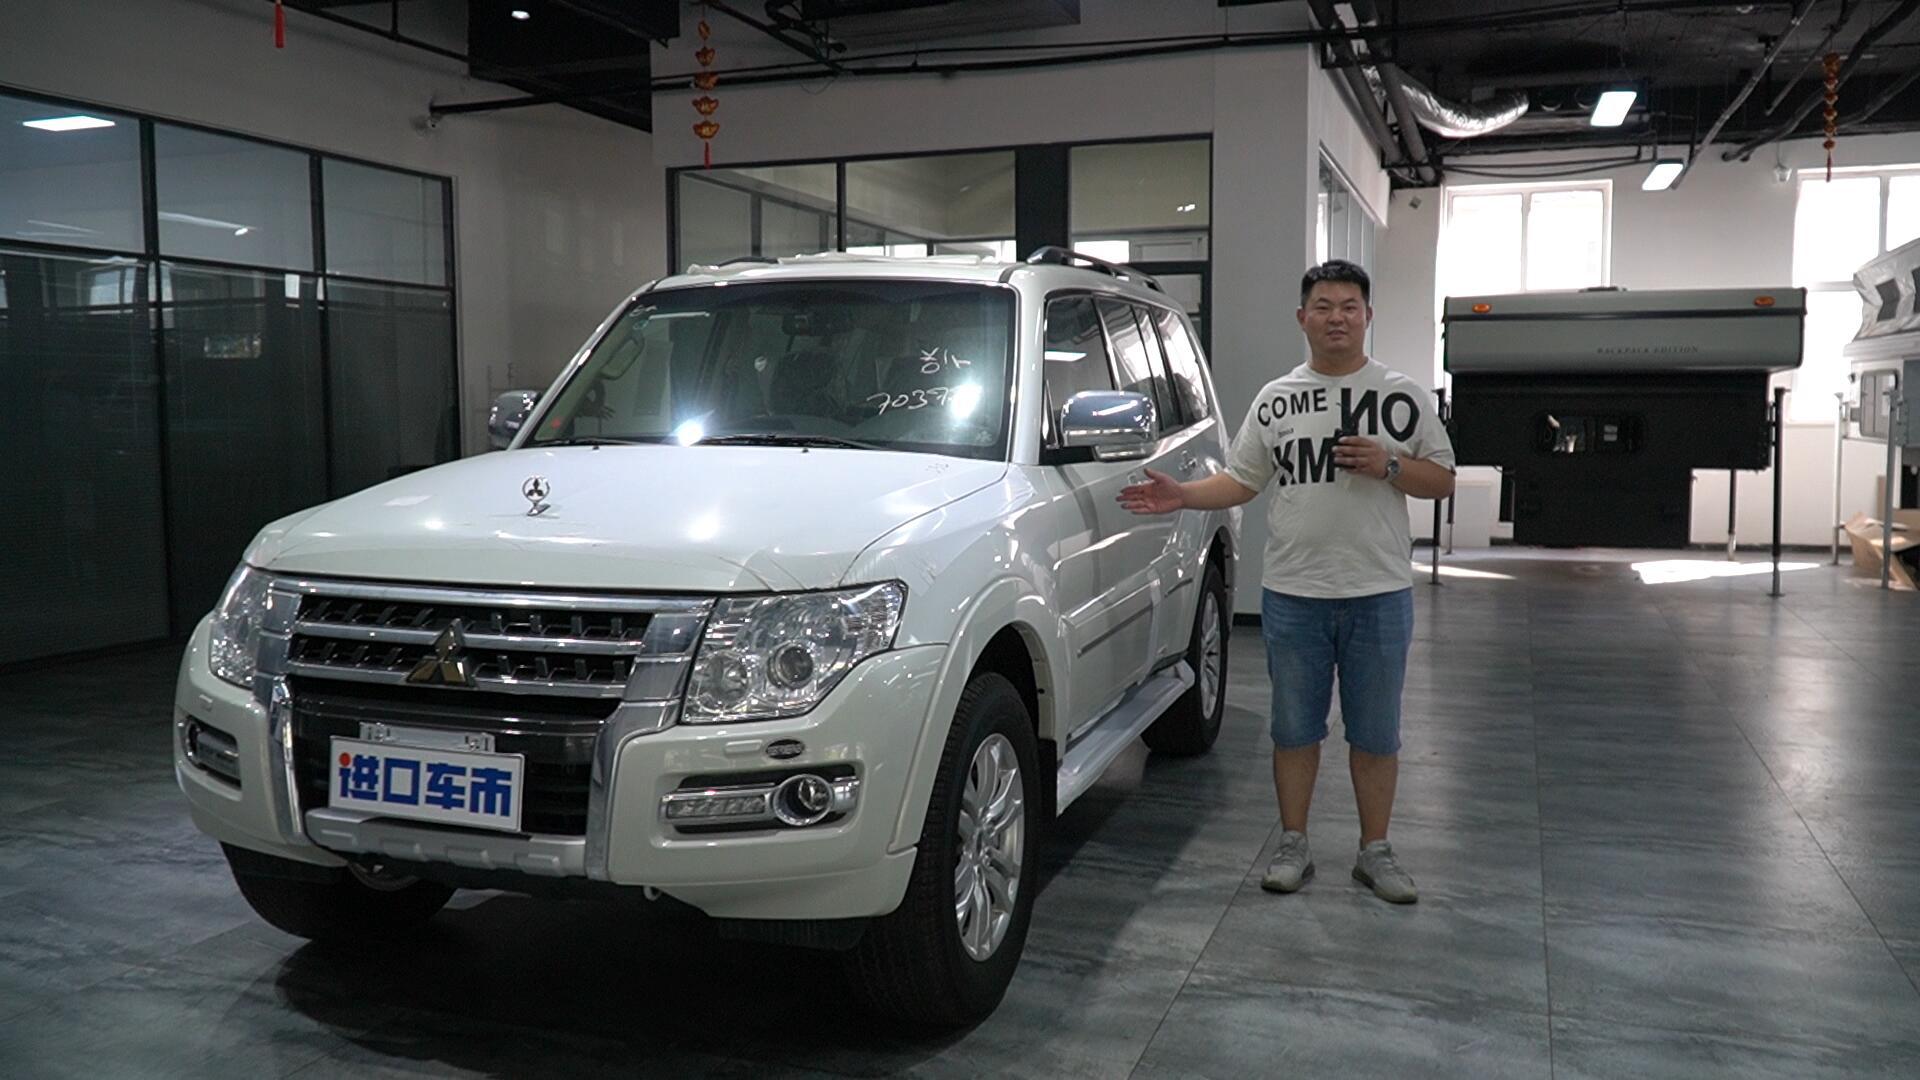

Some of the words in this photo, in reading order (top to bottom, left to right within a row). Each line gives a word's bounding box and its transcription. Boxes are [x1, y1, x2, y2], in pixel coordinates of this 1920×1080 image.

[1257, 387, 1329, 427] COME
[338, 751, 513, 817] 进口车市
